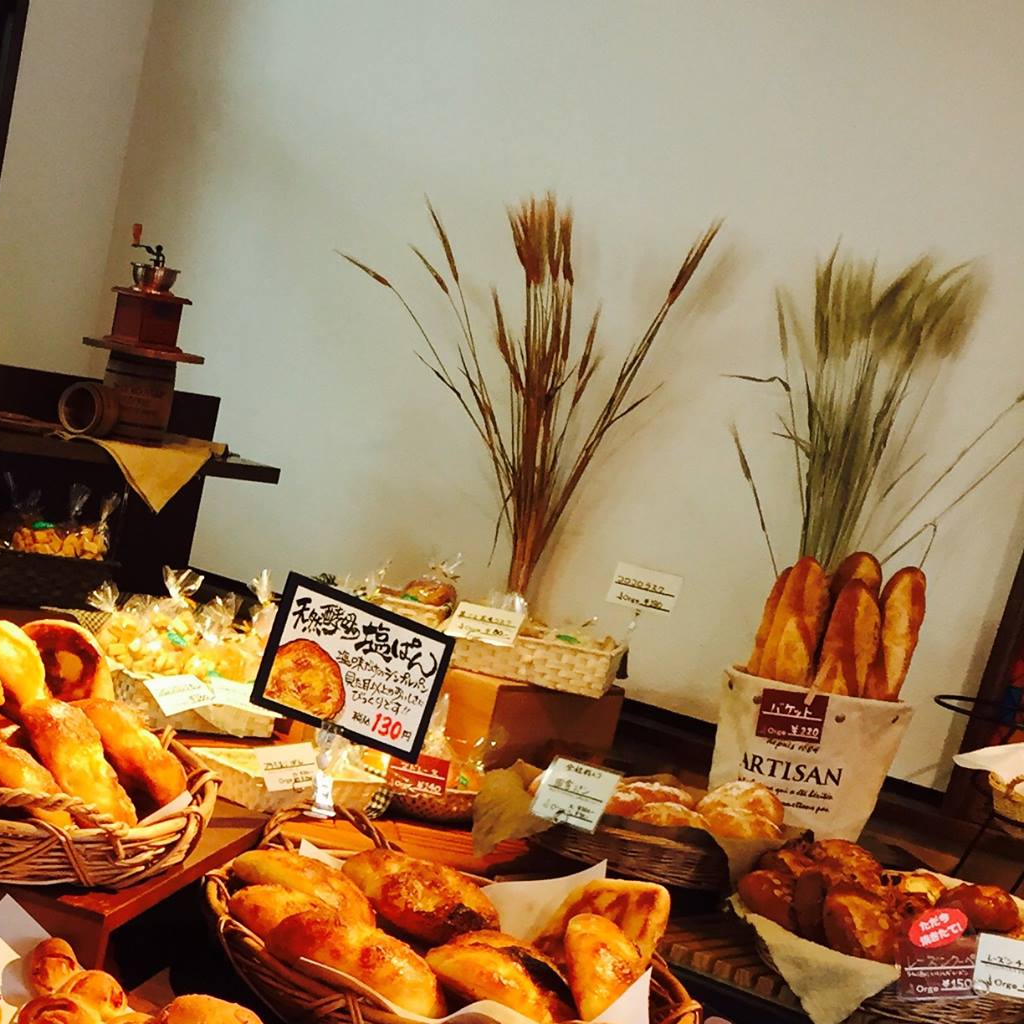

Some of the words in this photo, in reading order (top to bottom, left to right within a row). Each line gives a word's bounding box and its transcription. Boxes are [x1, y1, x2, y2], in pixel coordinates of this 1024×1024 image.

[770, 704, 813, 719] バケット
[739, 752, 844, 788] ARTISAN
